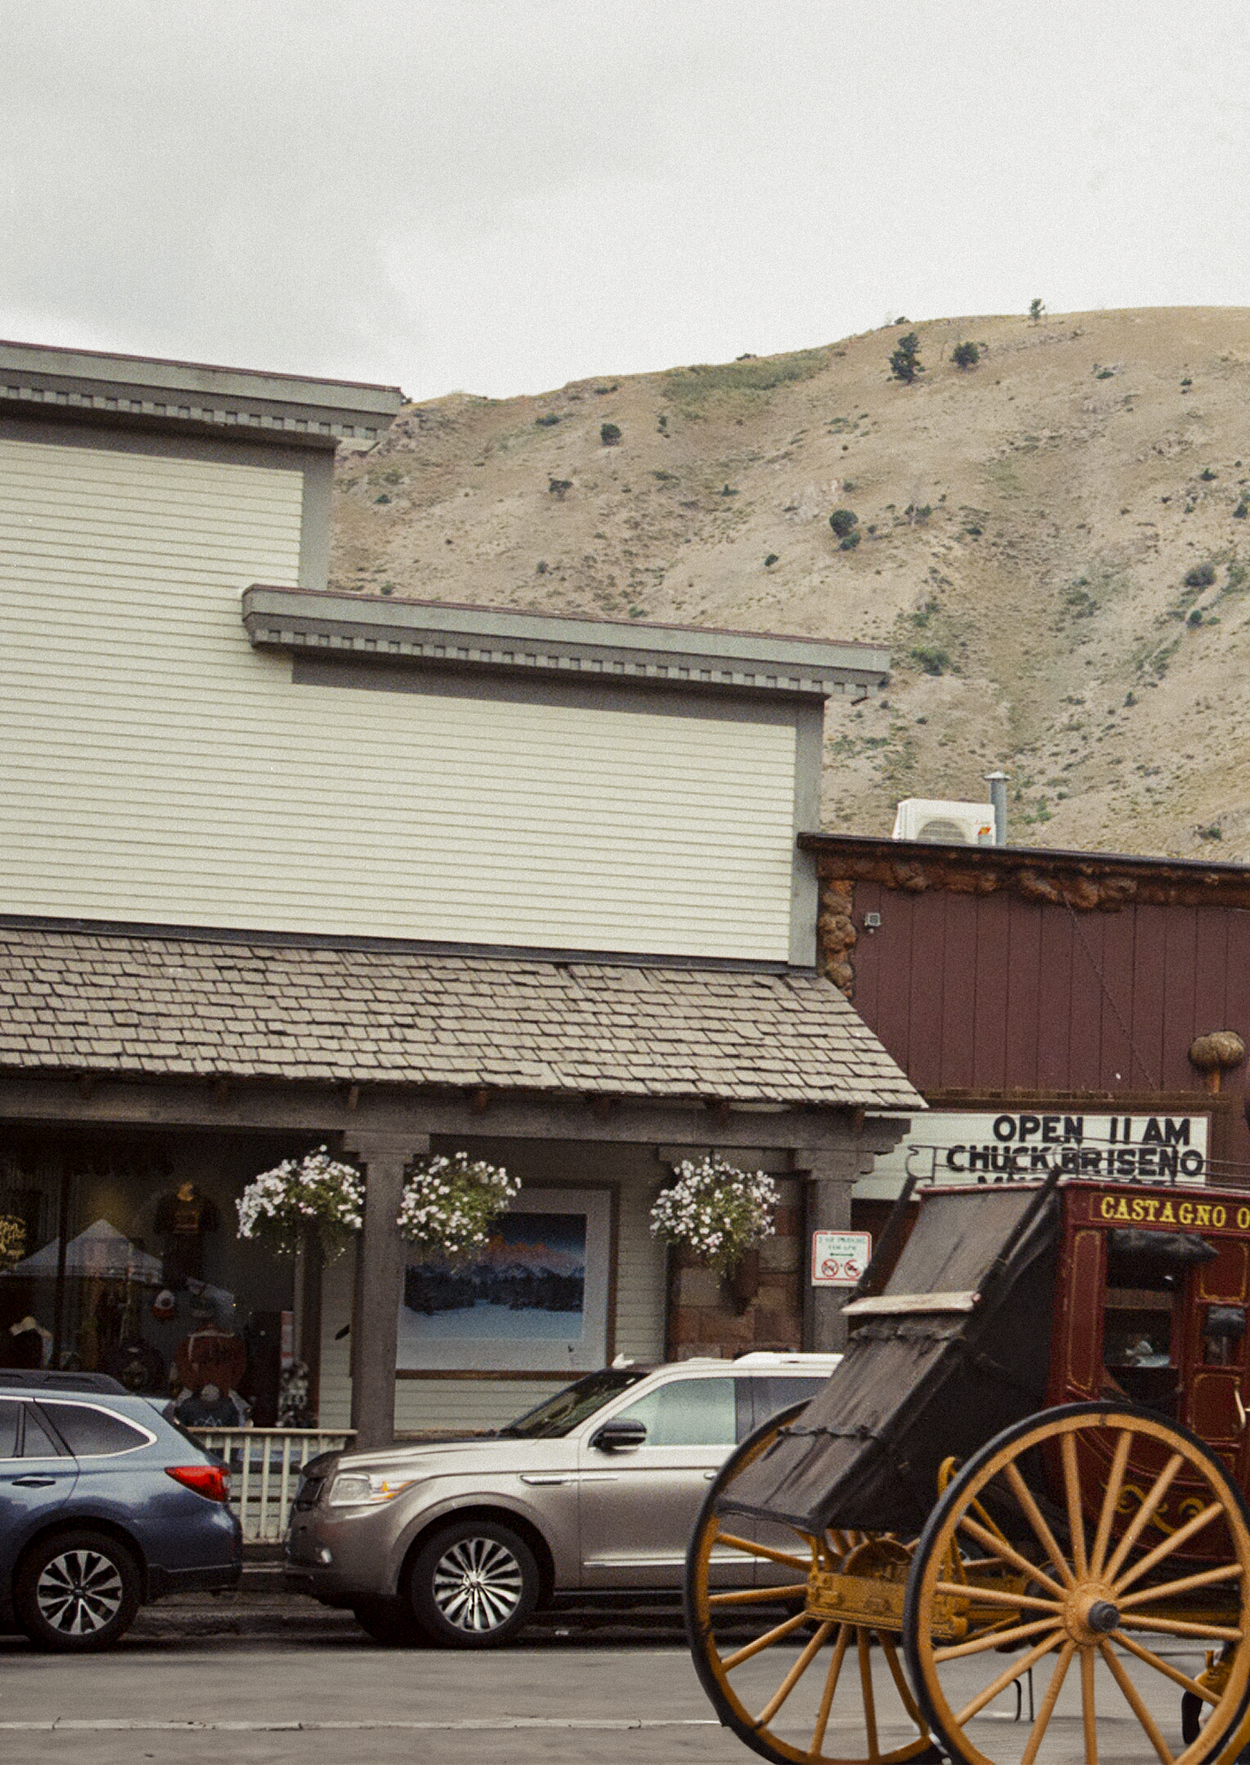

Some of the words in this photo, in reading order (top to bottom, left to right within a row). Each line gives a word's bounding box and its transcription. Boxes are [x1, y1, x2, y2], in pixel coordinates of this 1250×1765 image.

[993, 1114, 1083, 1144] OPEN
[946, 1144, 1052, 1173] CHUCK
[1061, 1146, 1203, 1177] BRISENO
[1100, 1196, 1227, 1228] CASTAGNO
